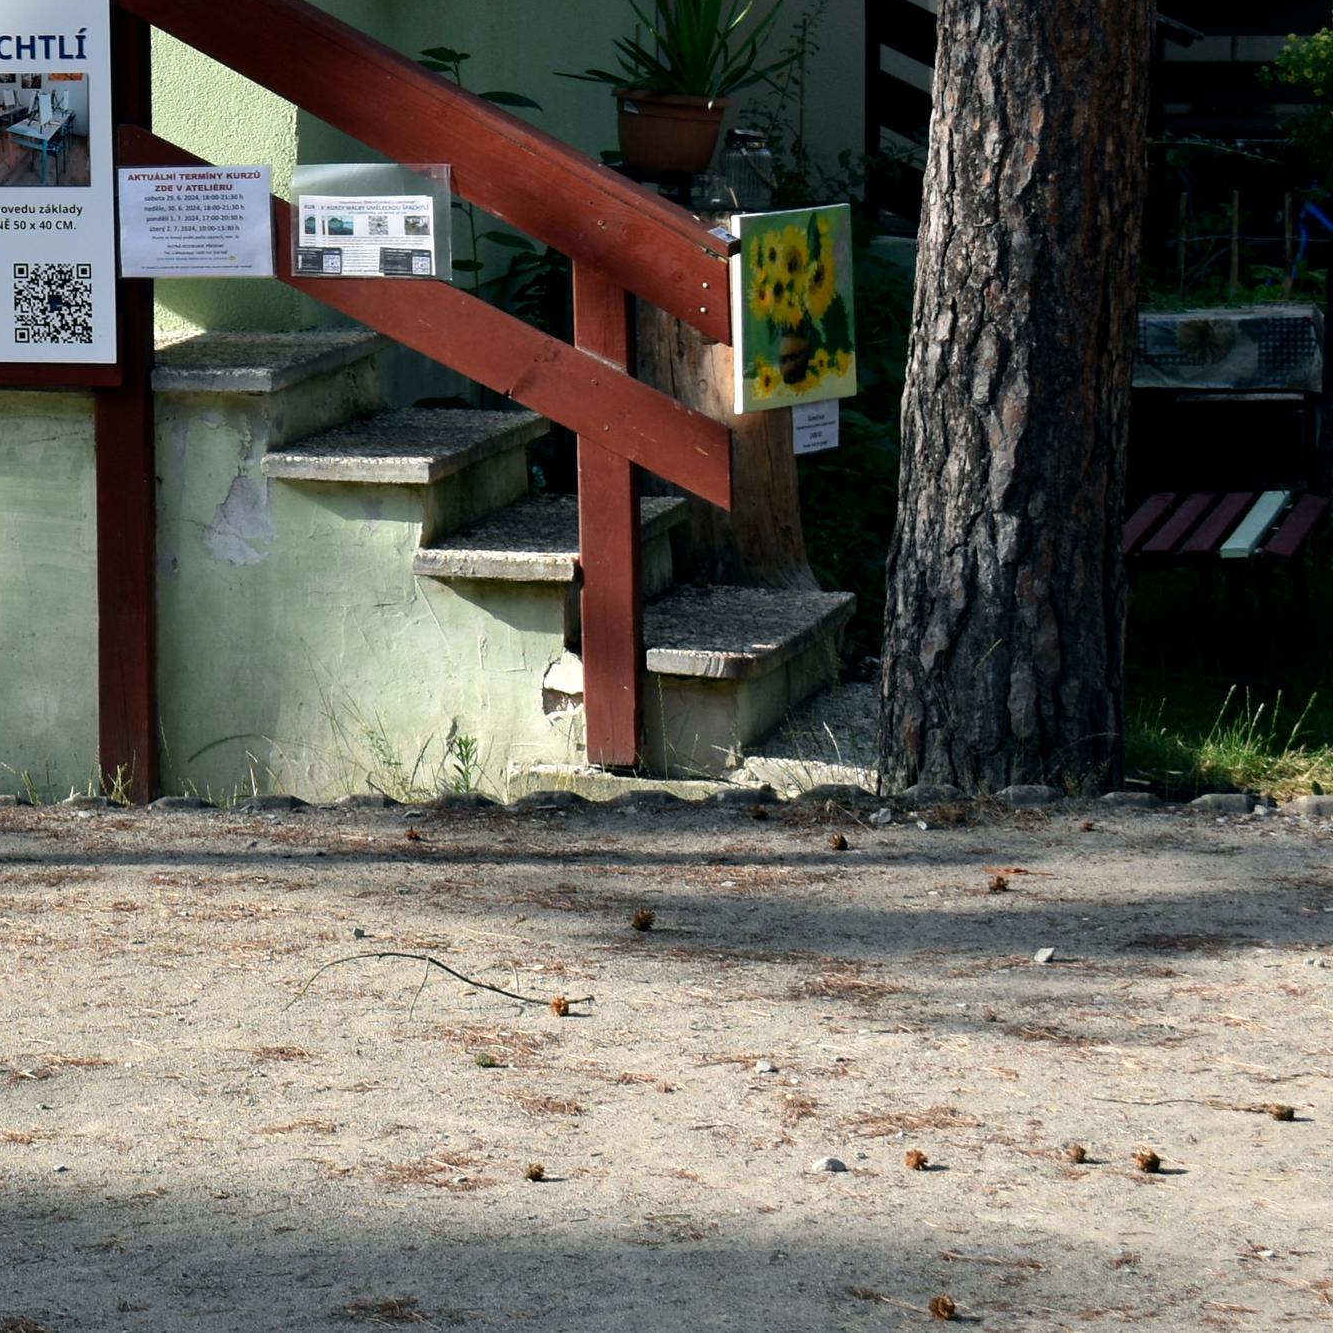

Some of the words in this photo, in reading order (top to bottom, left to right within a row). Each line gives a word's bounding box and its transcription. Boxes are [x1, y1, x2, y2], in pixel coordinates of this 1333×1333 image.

[128, 172, 176, 181] AKTUÁLNÍ
[179, 171, 222, 180] TERMÍNY
[226, 170, 261, 179] KURZŮ
[185, 182, 233, 191] ATELIÉRU
[39, 204, 83, 216] základy
[13, 220, 26, 230] 50
[39, 221, 52, 230] 40
[55, 221, 76, 230] CM.
